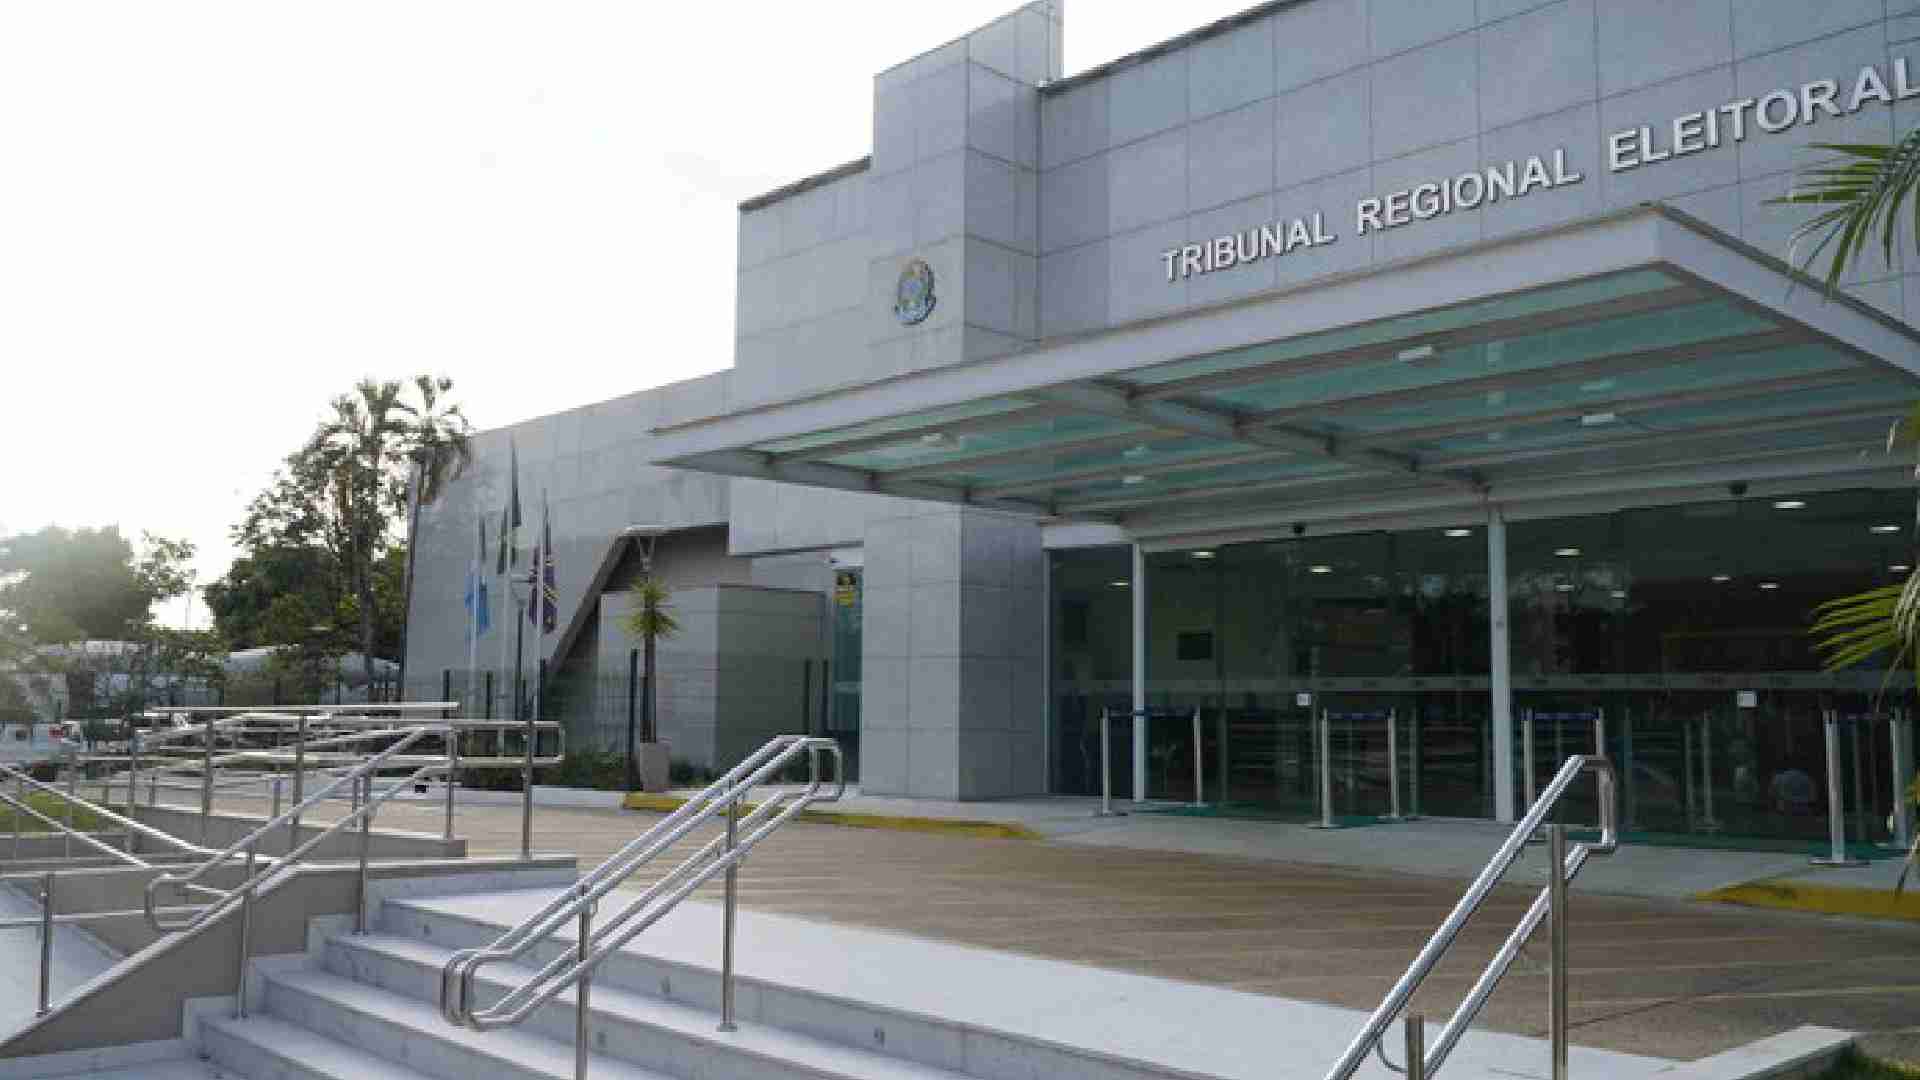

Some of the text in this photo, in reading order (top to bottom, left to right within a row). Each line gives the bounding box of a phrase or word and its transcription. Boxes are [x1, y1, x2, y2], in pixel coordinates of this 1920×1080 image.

[1162, 57, 1920, 281] TRIBUNAL REGIONAL ELEITORAL
